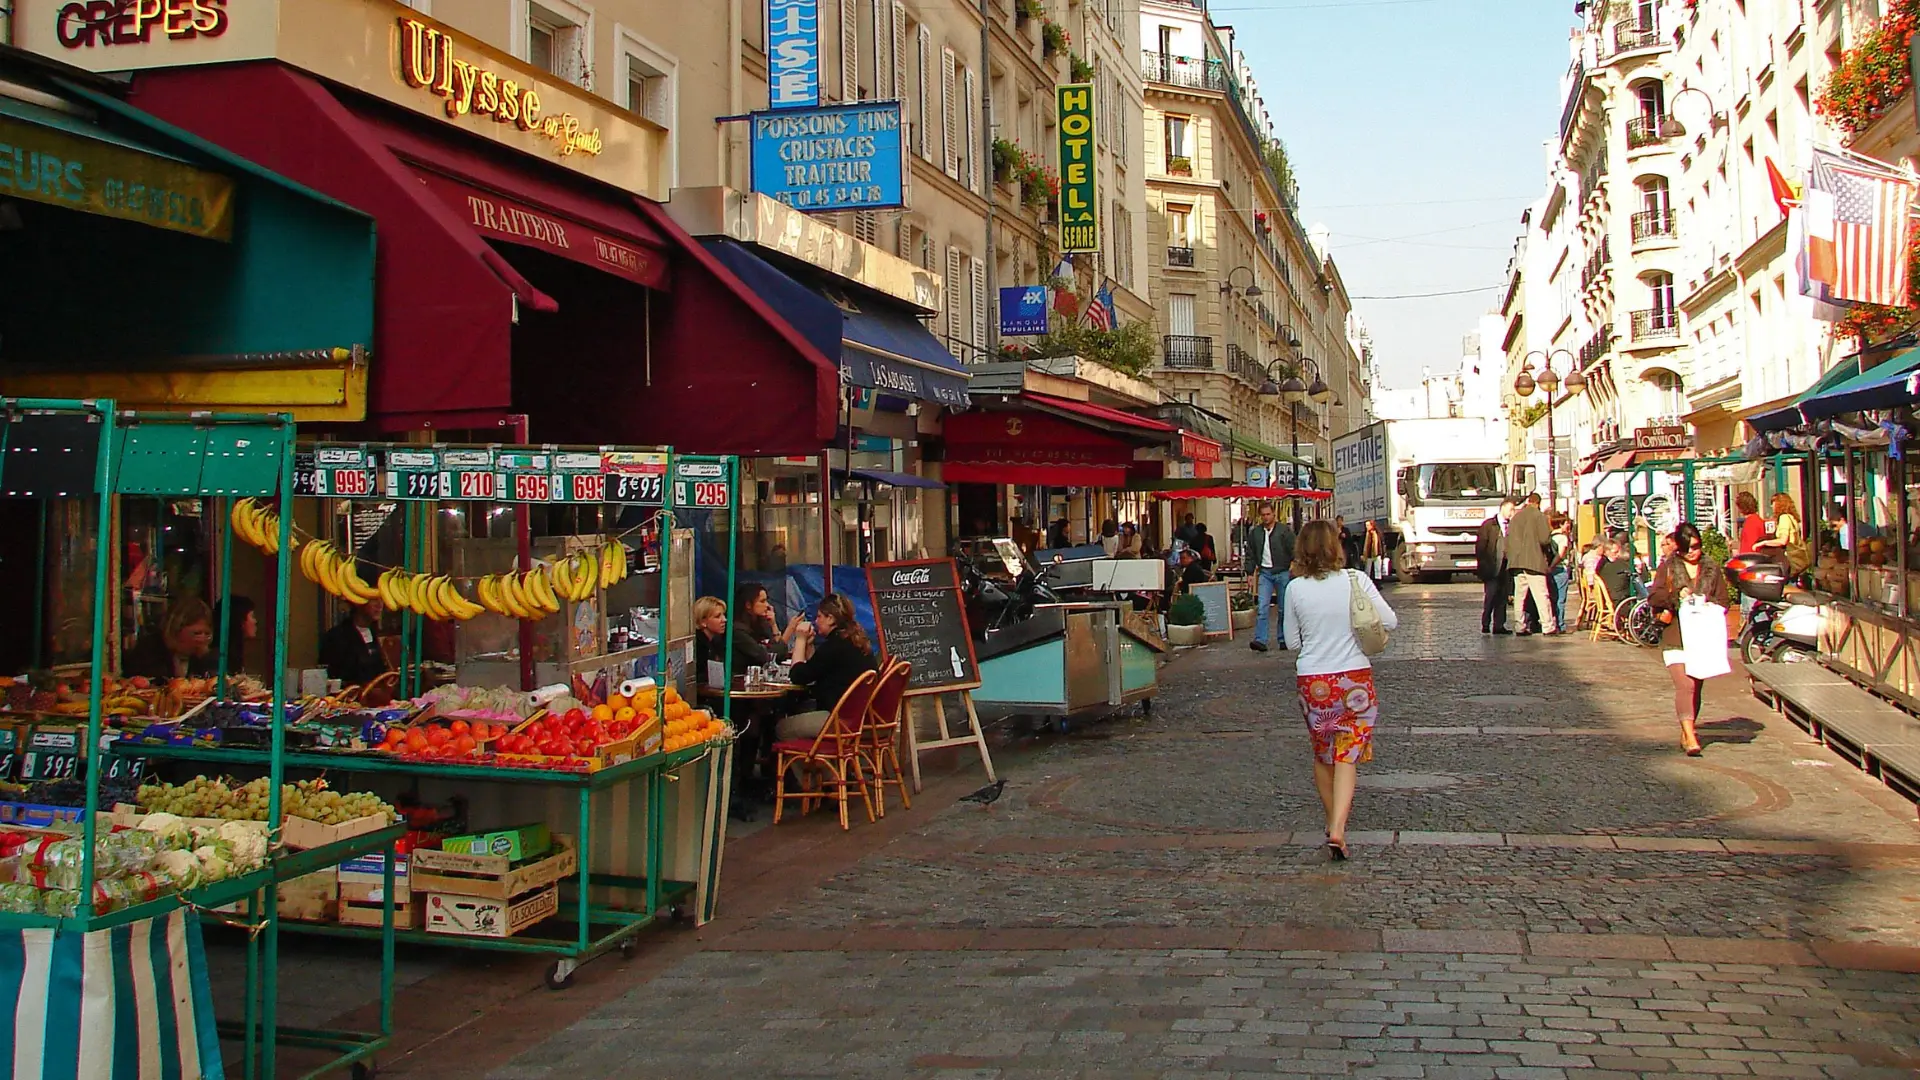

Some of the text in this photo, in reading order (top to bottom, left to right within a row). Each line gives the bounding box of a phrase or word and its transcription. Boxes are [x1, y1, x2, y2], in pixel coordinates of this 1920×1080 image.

[398, 16, 541, 132] Ulysse
[545, 112, 602, 156] en Gaule
[757, 110, 899, 140] POISSONS FINS
[778, 135, 876, 162] CRUSTACES
[1060, 89, 1094, 210] HOTEL
[784, 160, 872, 186] TRAITEUR
[467, 195, 570, 250] TRAITEUR
[1063, 211, 1093, 223] LA
[1063, 225, 1095, 249] SERRE
[1335, 434, 1383, 473] ETIENNE
[336, 470, 367, 494] 995
[408, 474, 438, 496] 395
[461, 472, 493, 496] 210
[516, 475, 549, 500] 595
[573, 475, 605, 500] 695
[695, 483, 727, 506] 295
[43, 755, 75, 778] 395
